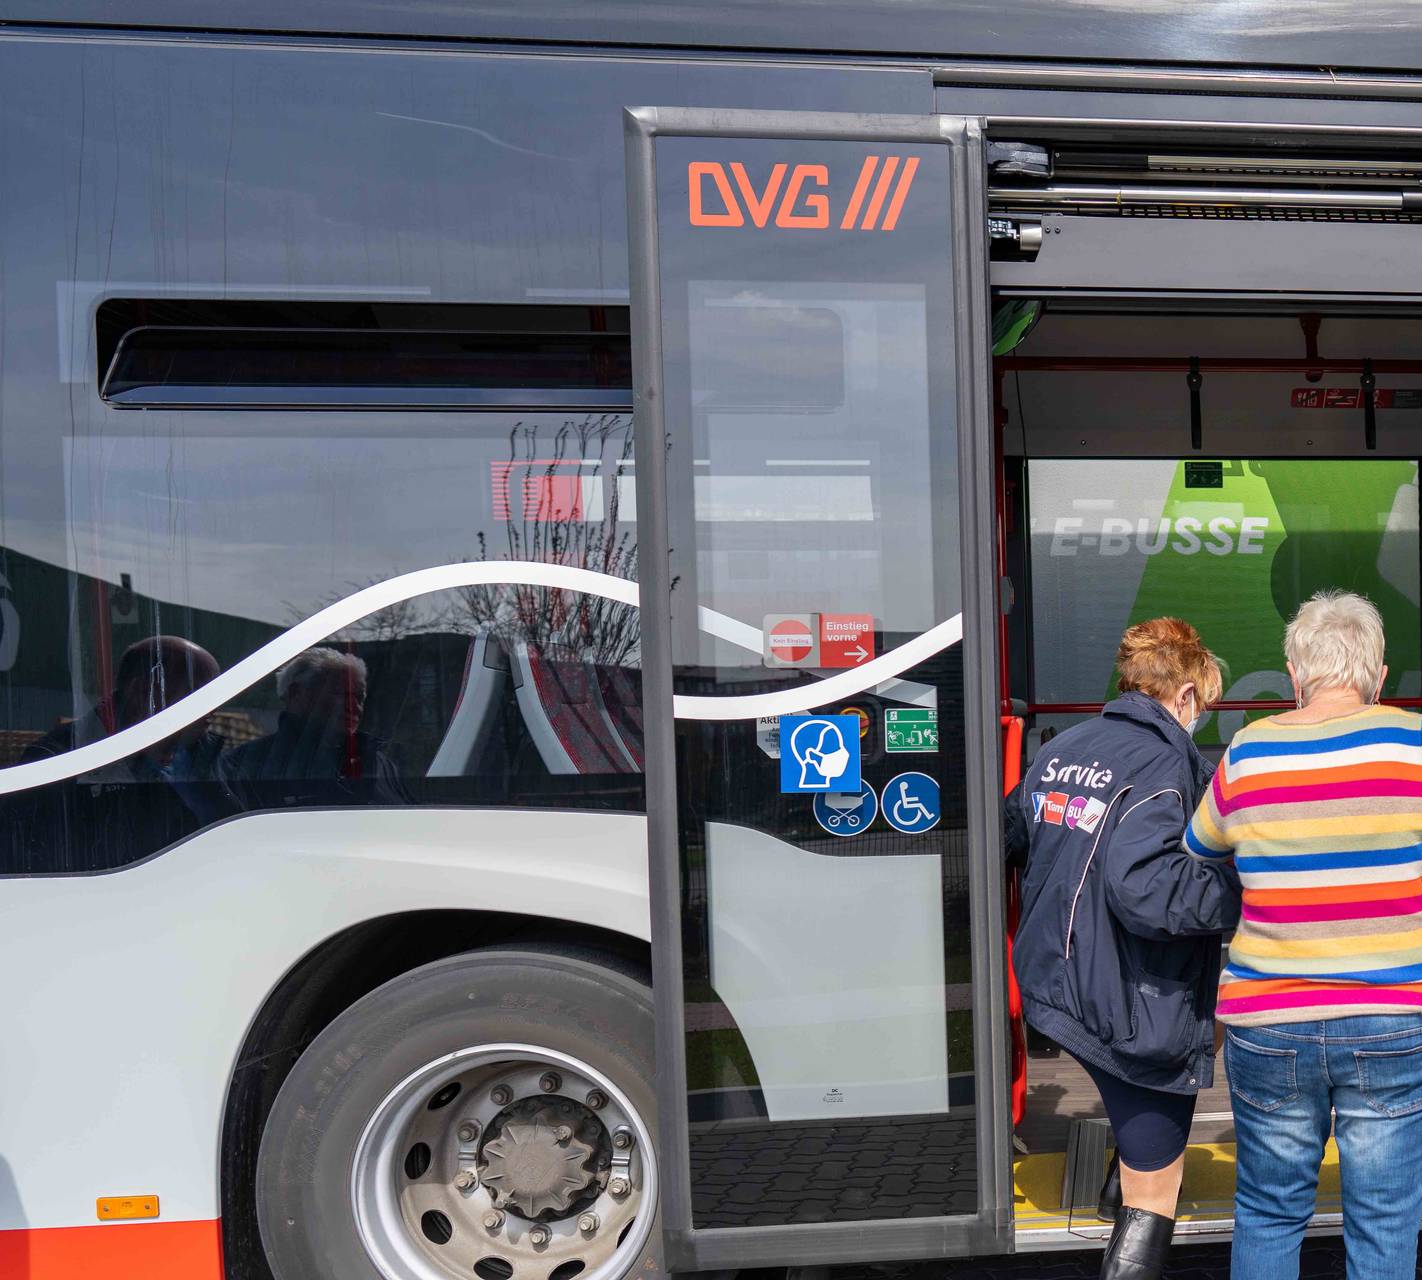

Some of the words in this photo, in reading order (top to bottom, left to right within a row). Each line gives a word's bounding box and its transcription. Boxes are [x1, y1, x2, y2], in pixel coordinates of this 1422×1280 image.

[688, 162, 830, 229] DVG
[1050, 516, 1270, 557] E-BUSSE
[826, 621, 869, 632] Einstieg
[826, 633, 858, 642] vorne
